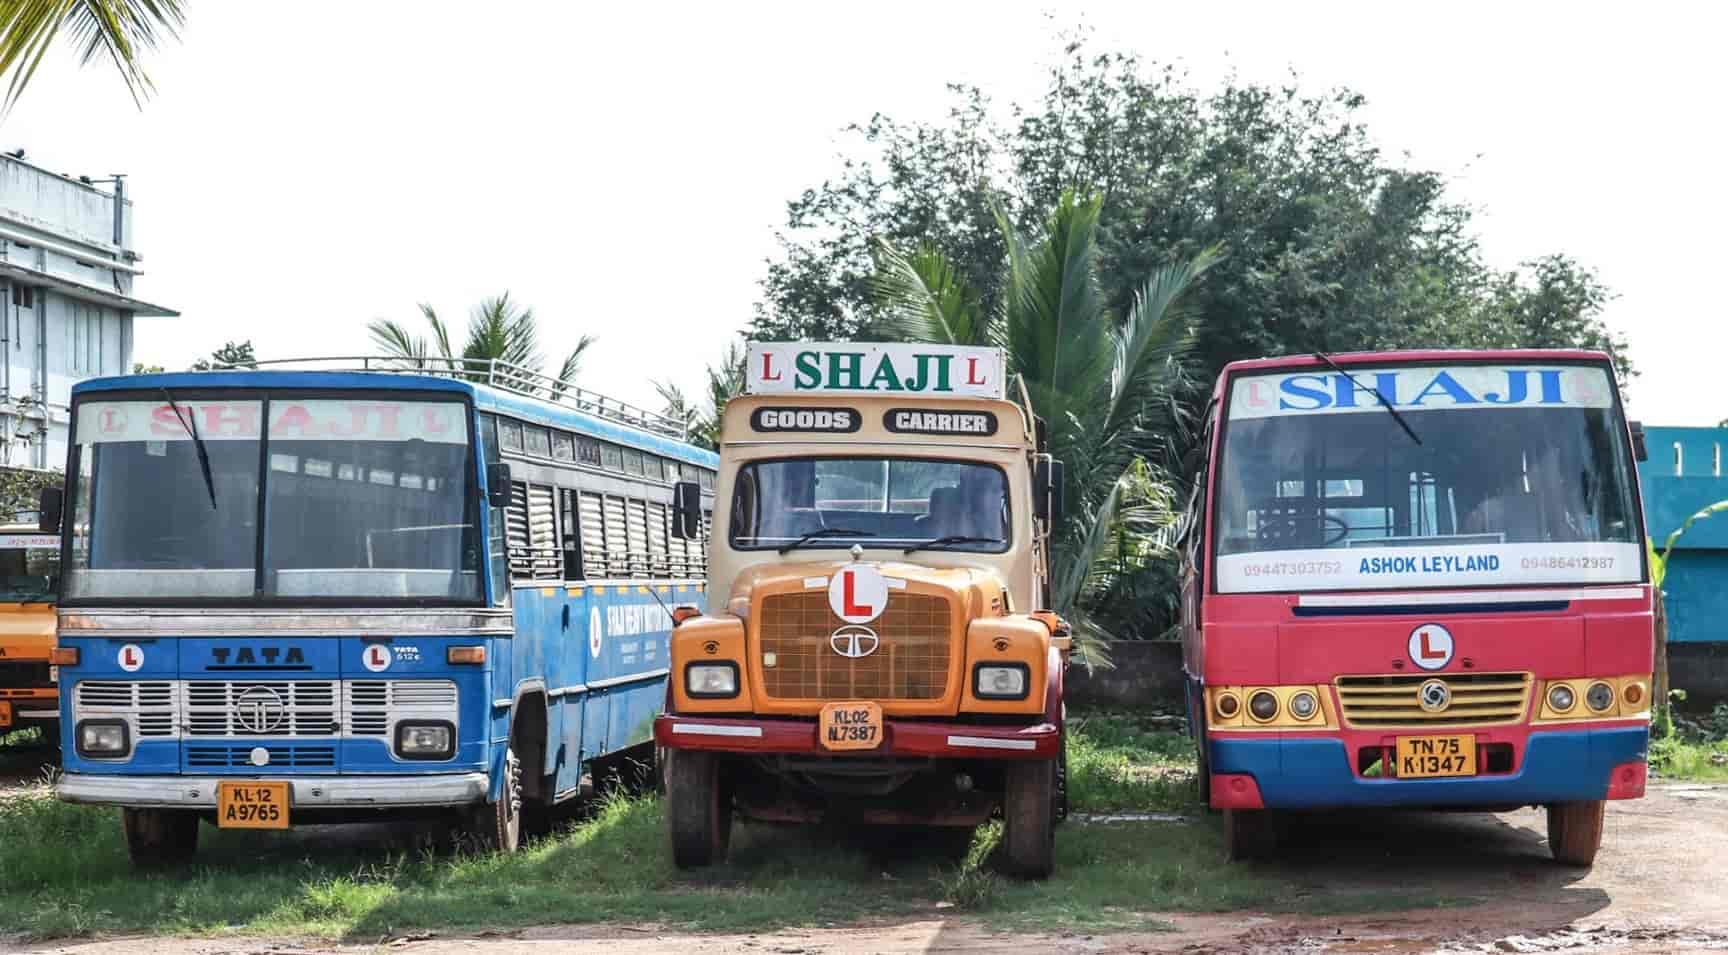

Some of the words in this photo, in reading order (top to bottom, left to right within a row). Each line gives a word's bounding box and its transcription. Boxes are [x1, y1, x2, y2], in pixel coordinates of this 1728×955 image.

[761, 352, 781, 380] L
[794, 351, 955, 392] SHAJI
[966, 358, 986, 385] L
[1248, 383, 1268, 406] L
[1280, 370, 1566, 410] SHAJI
[151, 404, 402, 437] SHAJI
[760, 410, 851, 429] GOODS
[895, 412, 988, 432] CARRIER
[1359, 557, 1417, 574] ASHOK
[1422, 555, 1500, 573] LEYLAND
[844, 571, 872, 616] L
[212, 647, 305, 664] TATA
[1420, 632, 1446, 659] L
[125, 648, 137, 666] L
[371, 648, 385, 665] L
[1409, 739, 1433, 754] TN
[1438, 738, 1459, 754] 75
[226, 804, 280, 821] A9765
